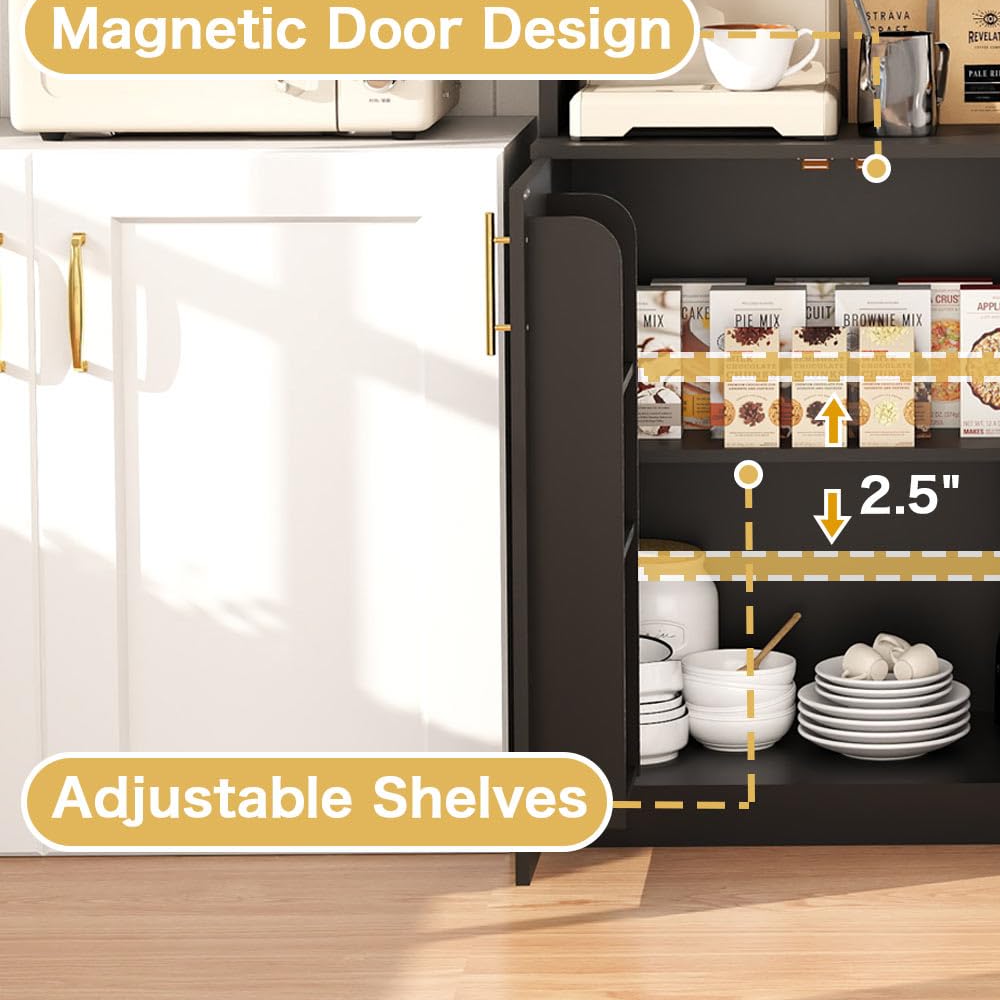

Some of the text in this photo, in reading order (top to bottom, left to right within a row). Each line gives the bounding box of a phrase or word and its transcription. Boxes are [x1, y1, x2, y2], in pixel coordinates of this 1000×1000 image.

[866, 11, 910, 20] STRAVA
[968, 69, 987, 78] PALE
[681, 306, 710, 320] CAKE
[844, 313, 923, 327] BROWNIE MIX
[643, 314, 664, 328] MIX
[759, 313, 780, 328] MIX
